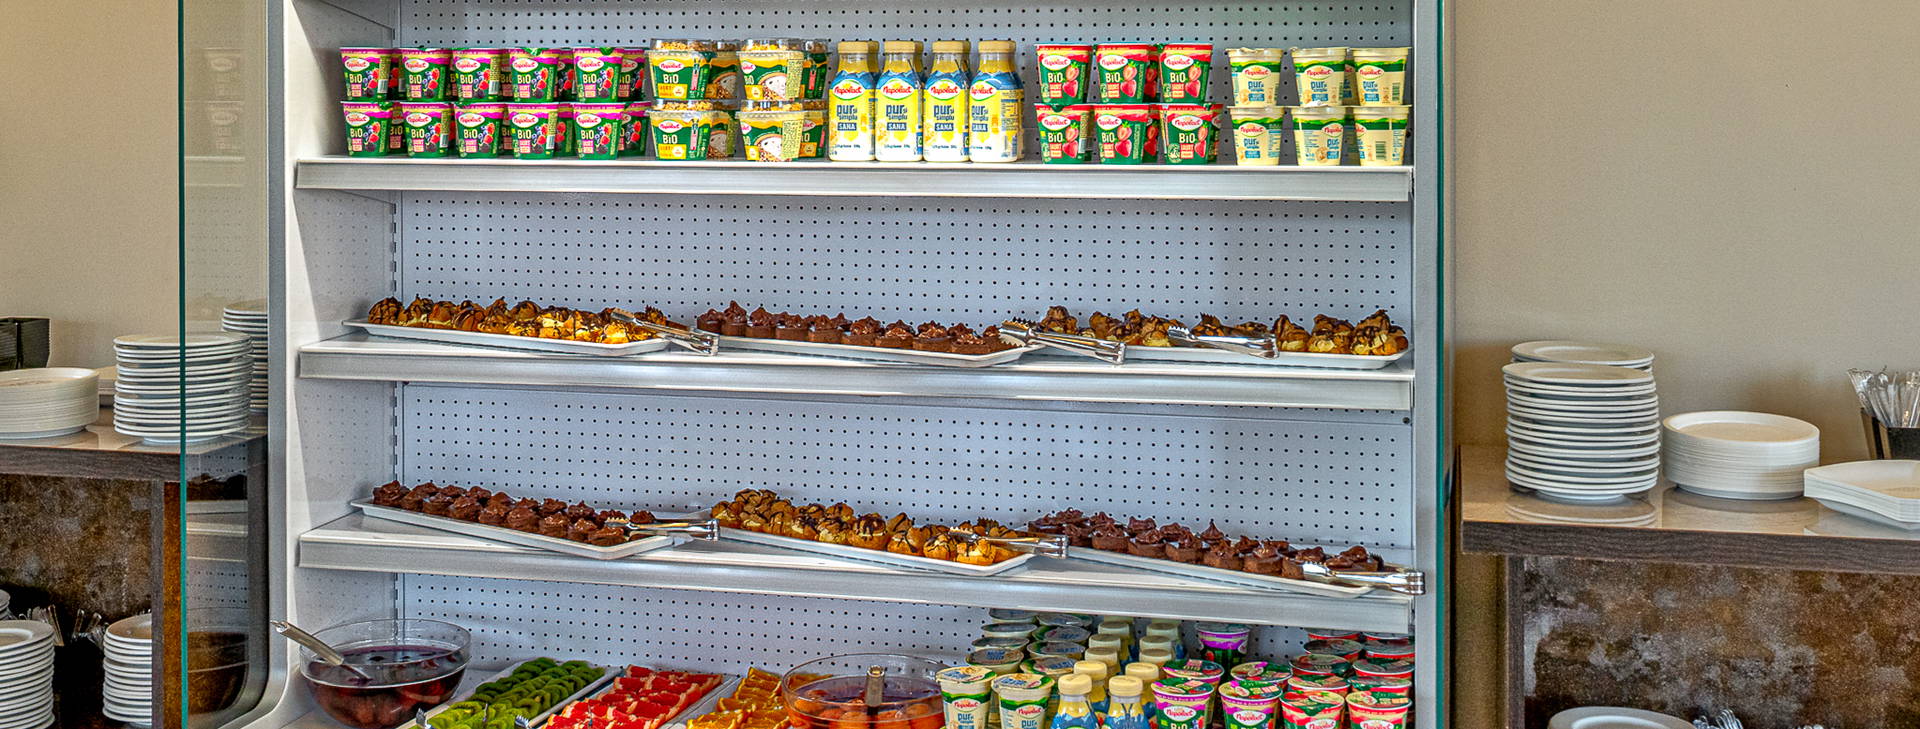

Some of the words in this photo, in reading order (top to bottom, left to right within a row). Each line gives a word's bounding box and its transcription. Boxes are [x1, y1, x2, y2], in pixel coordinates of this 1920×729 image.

[834, 85, 862, 97] Napolact
[882, 85, 911, 97] Napolact
[930, 85, 959, 97] Napolact
[836, 104, 853, 117] pur
[886, 104, 902, 117] pur
[933, 105, 951, 117] pur
[971, 105, 984, 117] pur
[839, 114, 858, 122] simplu
[888, 114, 908, 122] simplu
[957, 713, 971, 721] pur
